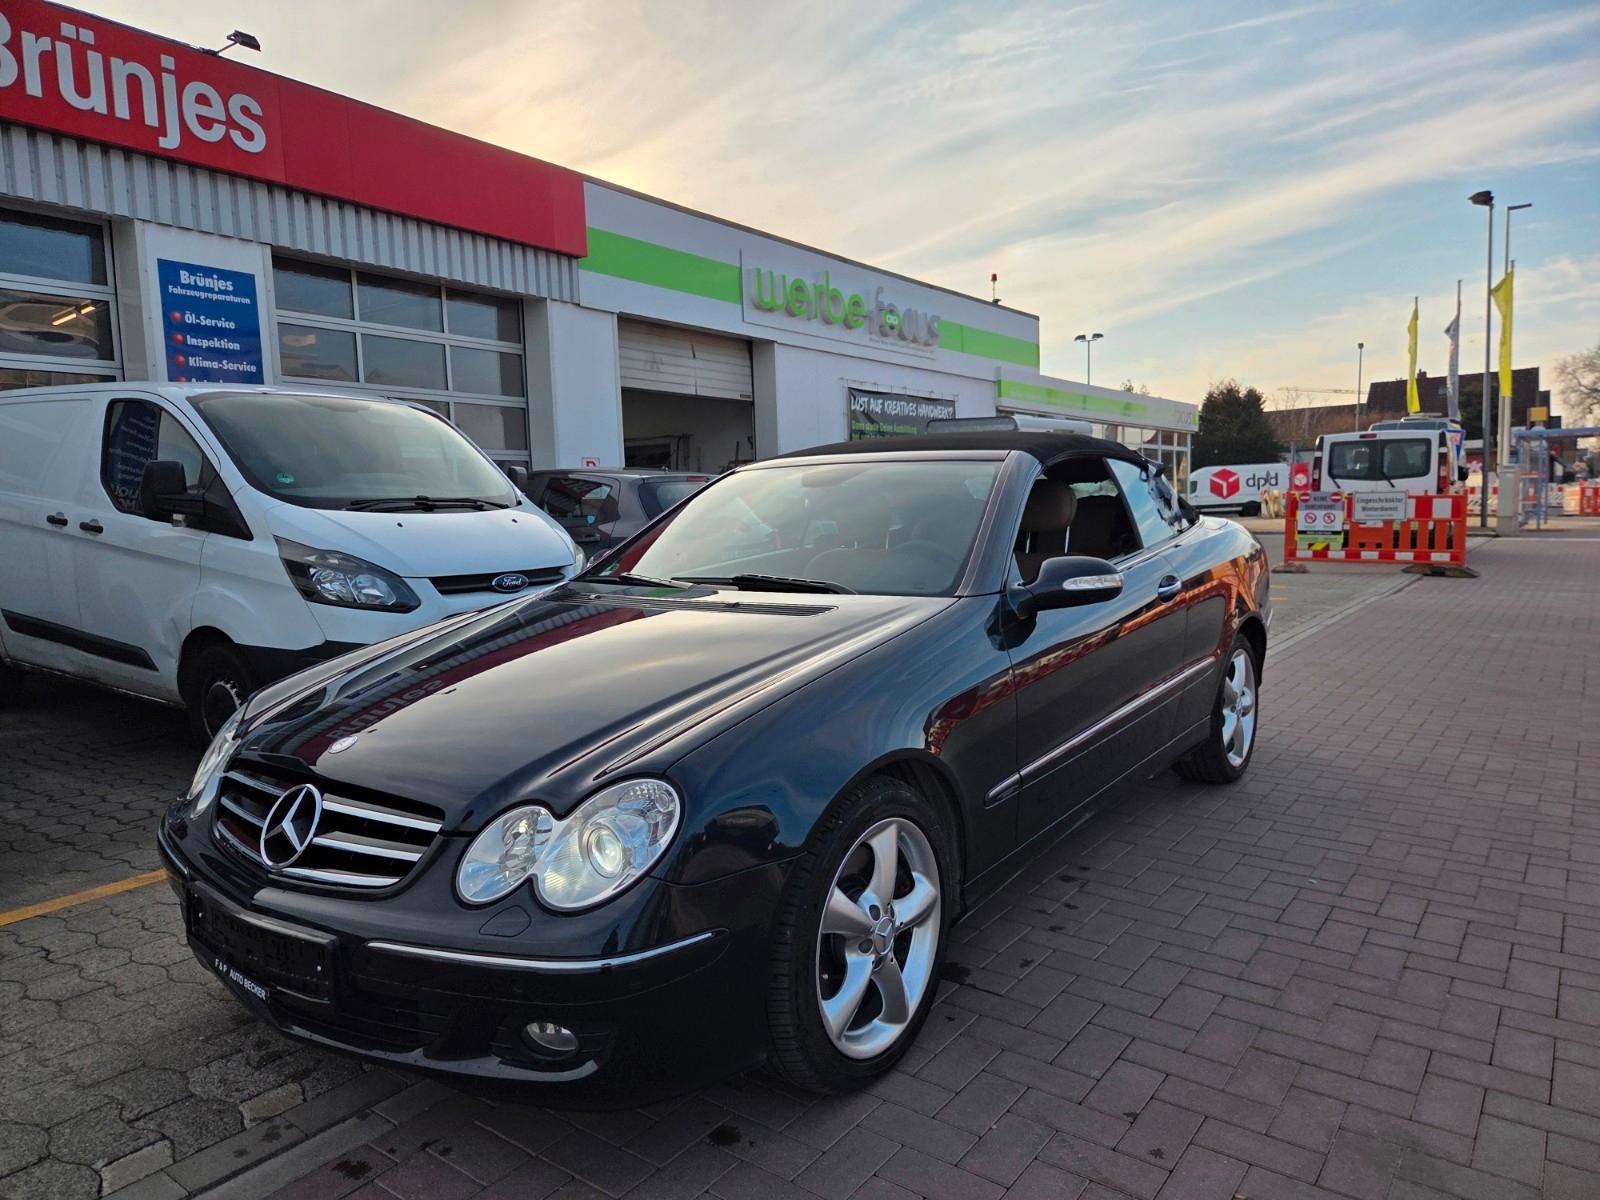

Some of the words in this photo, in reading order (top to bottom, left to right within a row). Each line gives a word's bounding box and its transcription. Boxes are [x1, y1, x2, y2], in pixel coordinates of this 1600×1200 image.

[180, 270, 234, 291] Brünjes
[168, 285, 251, 304] Fahrzeugreparaturen
[752, 267, 866, 330] werbe
[184, 311, 236, 330] Öl-Service
[186, 335, 241, 351] Inspektion
[188, 356, 257, 373] Klima-Service
[851, 396, 869, 413] LUST
[870, 398, 882, 414] AUF
[884, 400, 917, 417] KREATIVES
[1246, 470, 1279, 491] dpd
[502, 576, 522, 587] Ford
[229, 968, 243, 985] AUTO
[244, 979, 265, 1000] BECKER
